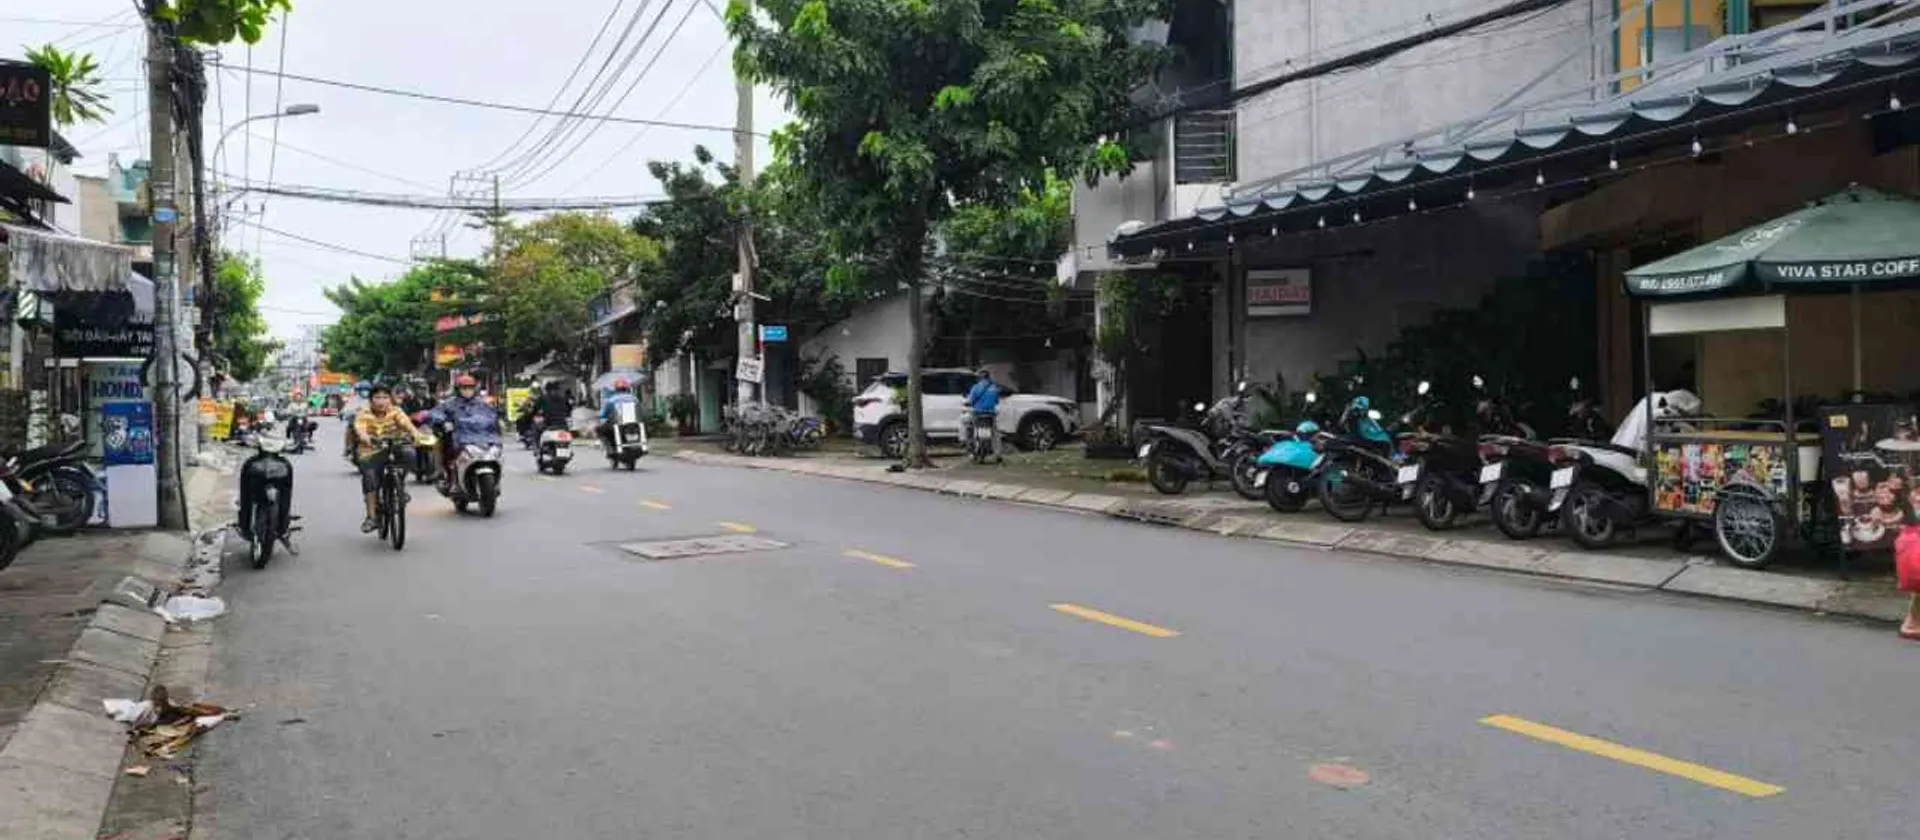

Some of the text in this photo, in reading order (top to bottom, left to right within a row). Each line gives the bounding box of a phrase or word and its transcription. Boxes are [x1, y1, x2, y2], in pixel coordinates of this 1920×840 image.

[1777, 259, 1920, 278] VIVA STAR COFF
